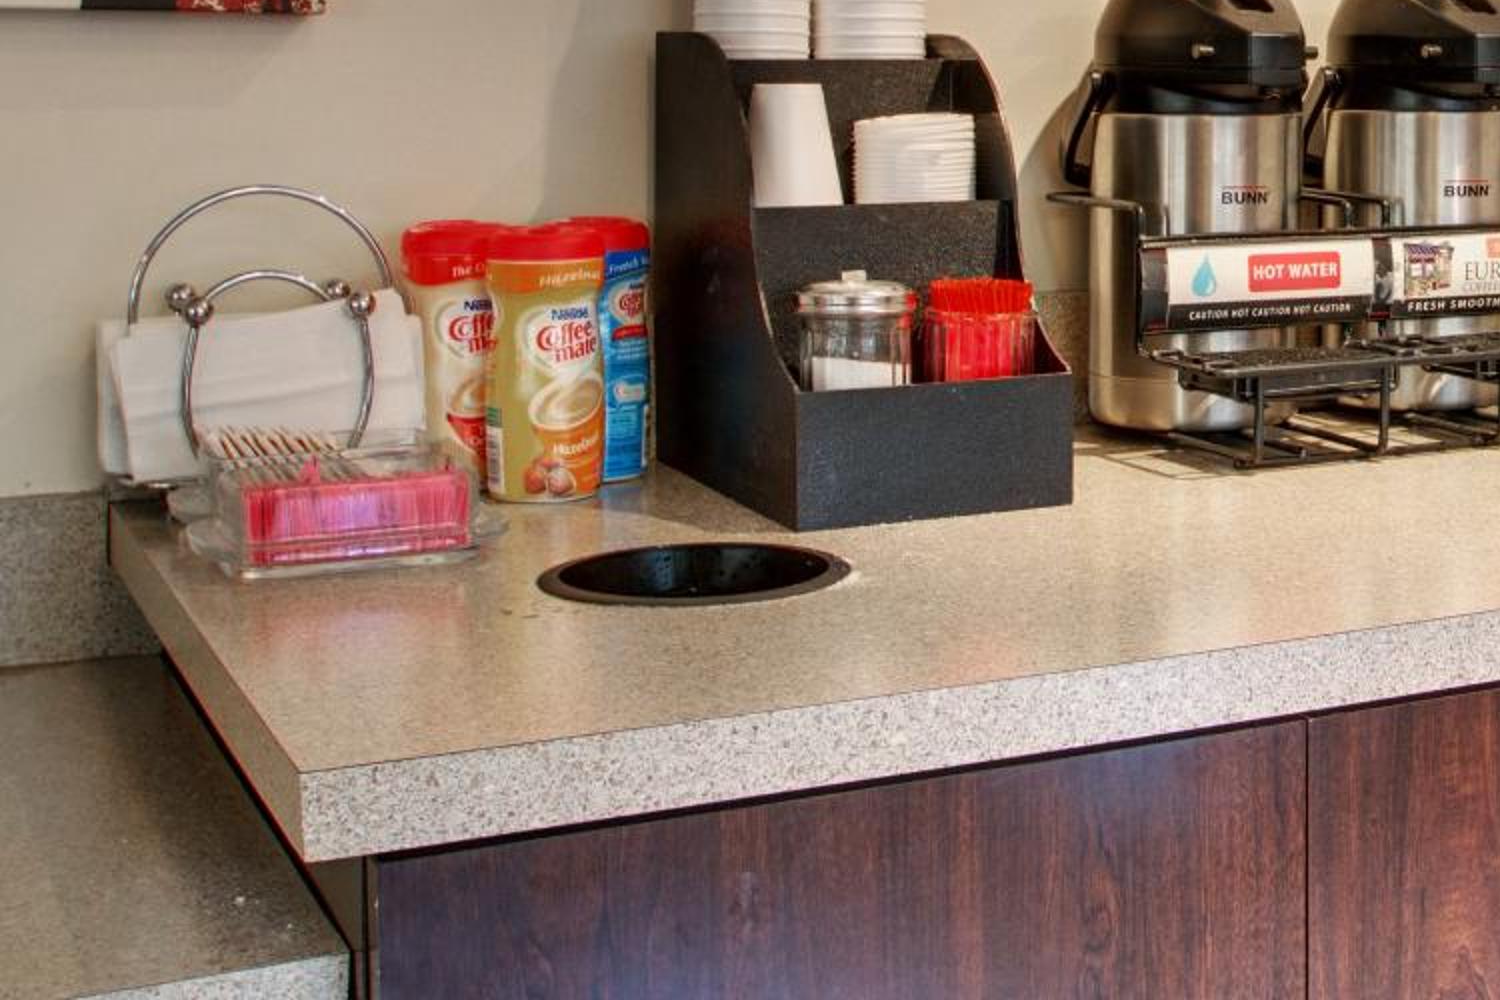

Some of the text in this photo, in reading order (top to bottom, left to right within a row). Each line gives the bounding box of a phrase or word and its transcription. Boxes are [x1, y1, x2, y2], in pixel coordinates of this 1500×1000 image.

[1221, 191, 1268, 205] BUNN
[1444, 185, 1489, 198] BUNN
[1252, 262, 1338, 280] HOT WATER
[1189, 309, 1229, 321] CAUTION
[1251, 306, 1291, 317] CAUTION
[1313, 302, 1351, 313] CAUTION
[1407, 298, 1446, 312] FRESH
[1449, 296, 1500, 310] SMOOTH
[536, 320, 594, 351] Coffee
[554, 336, 597, 362] mate
